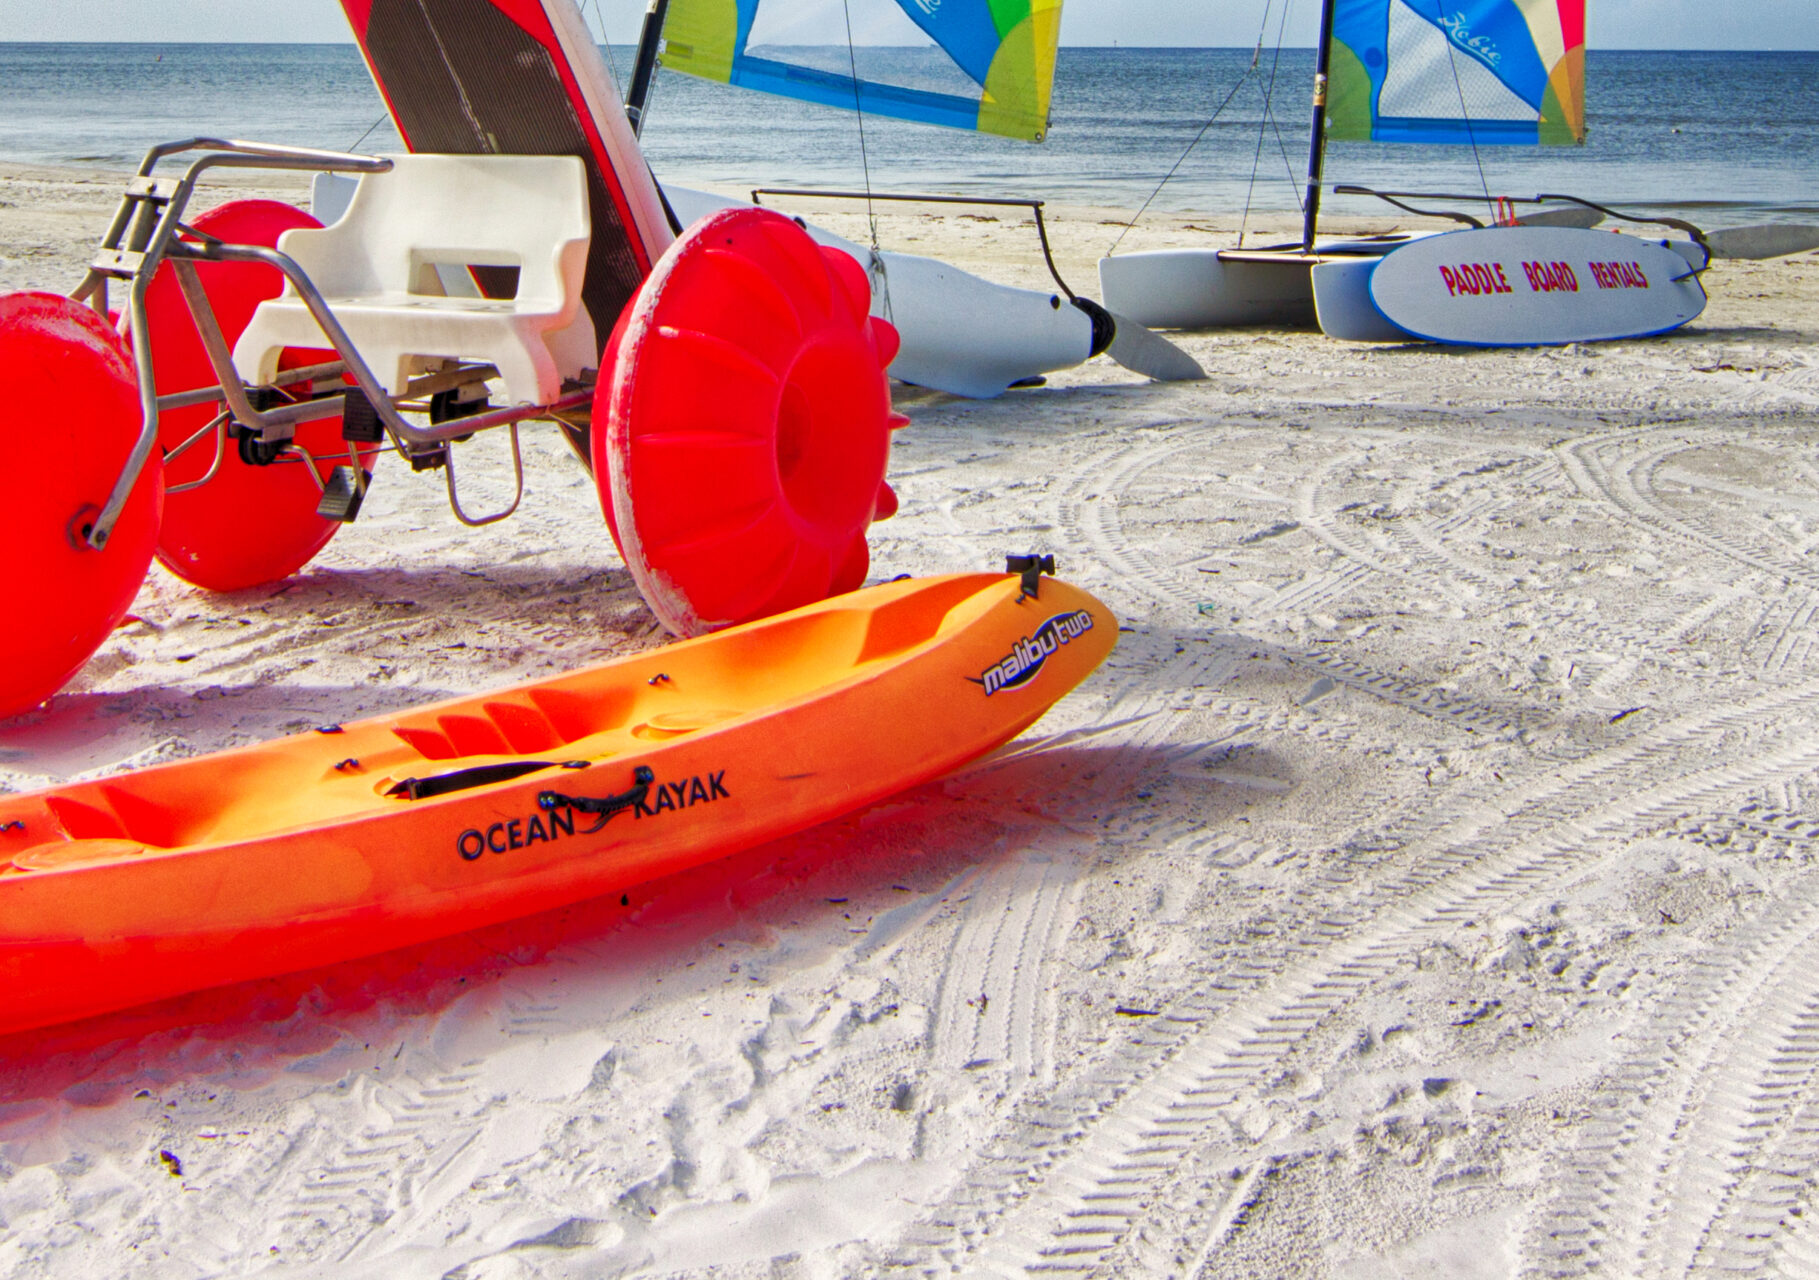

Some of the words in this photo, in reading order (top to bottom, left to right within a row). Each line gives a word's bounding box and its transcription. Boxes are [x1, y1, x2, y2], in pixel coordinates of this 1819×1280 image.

[1437, 11, 1502, 67] Hobie
[1439, 263, 1512, 296] PADDLE
[1522, 261, 1579, 292] BOARD
[1589, 261, 1648, 289] RENTALS
[982, 635, 1058, 696] malibu
[1051, 609, 1094, 645] two
[457, 807, 575, 861] OCEAN
[634, 770, 730, 819] KAYAK
